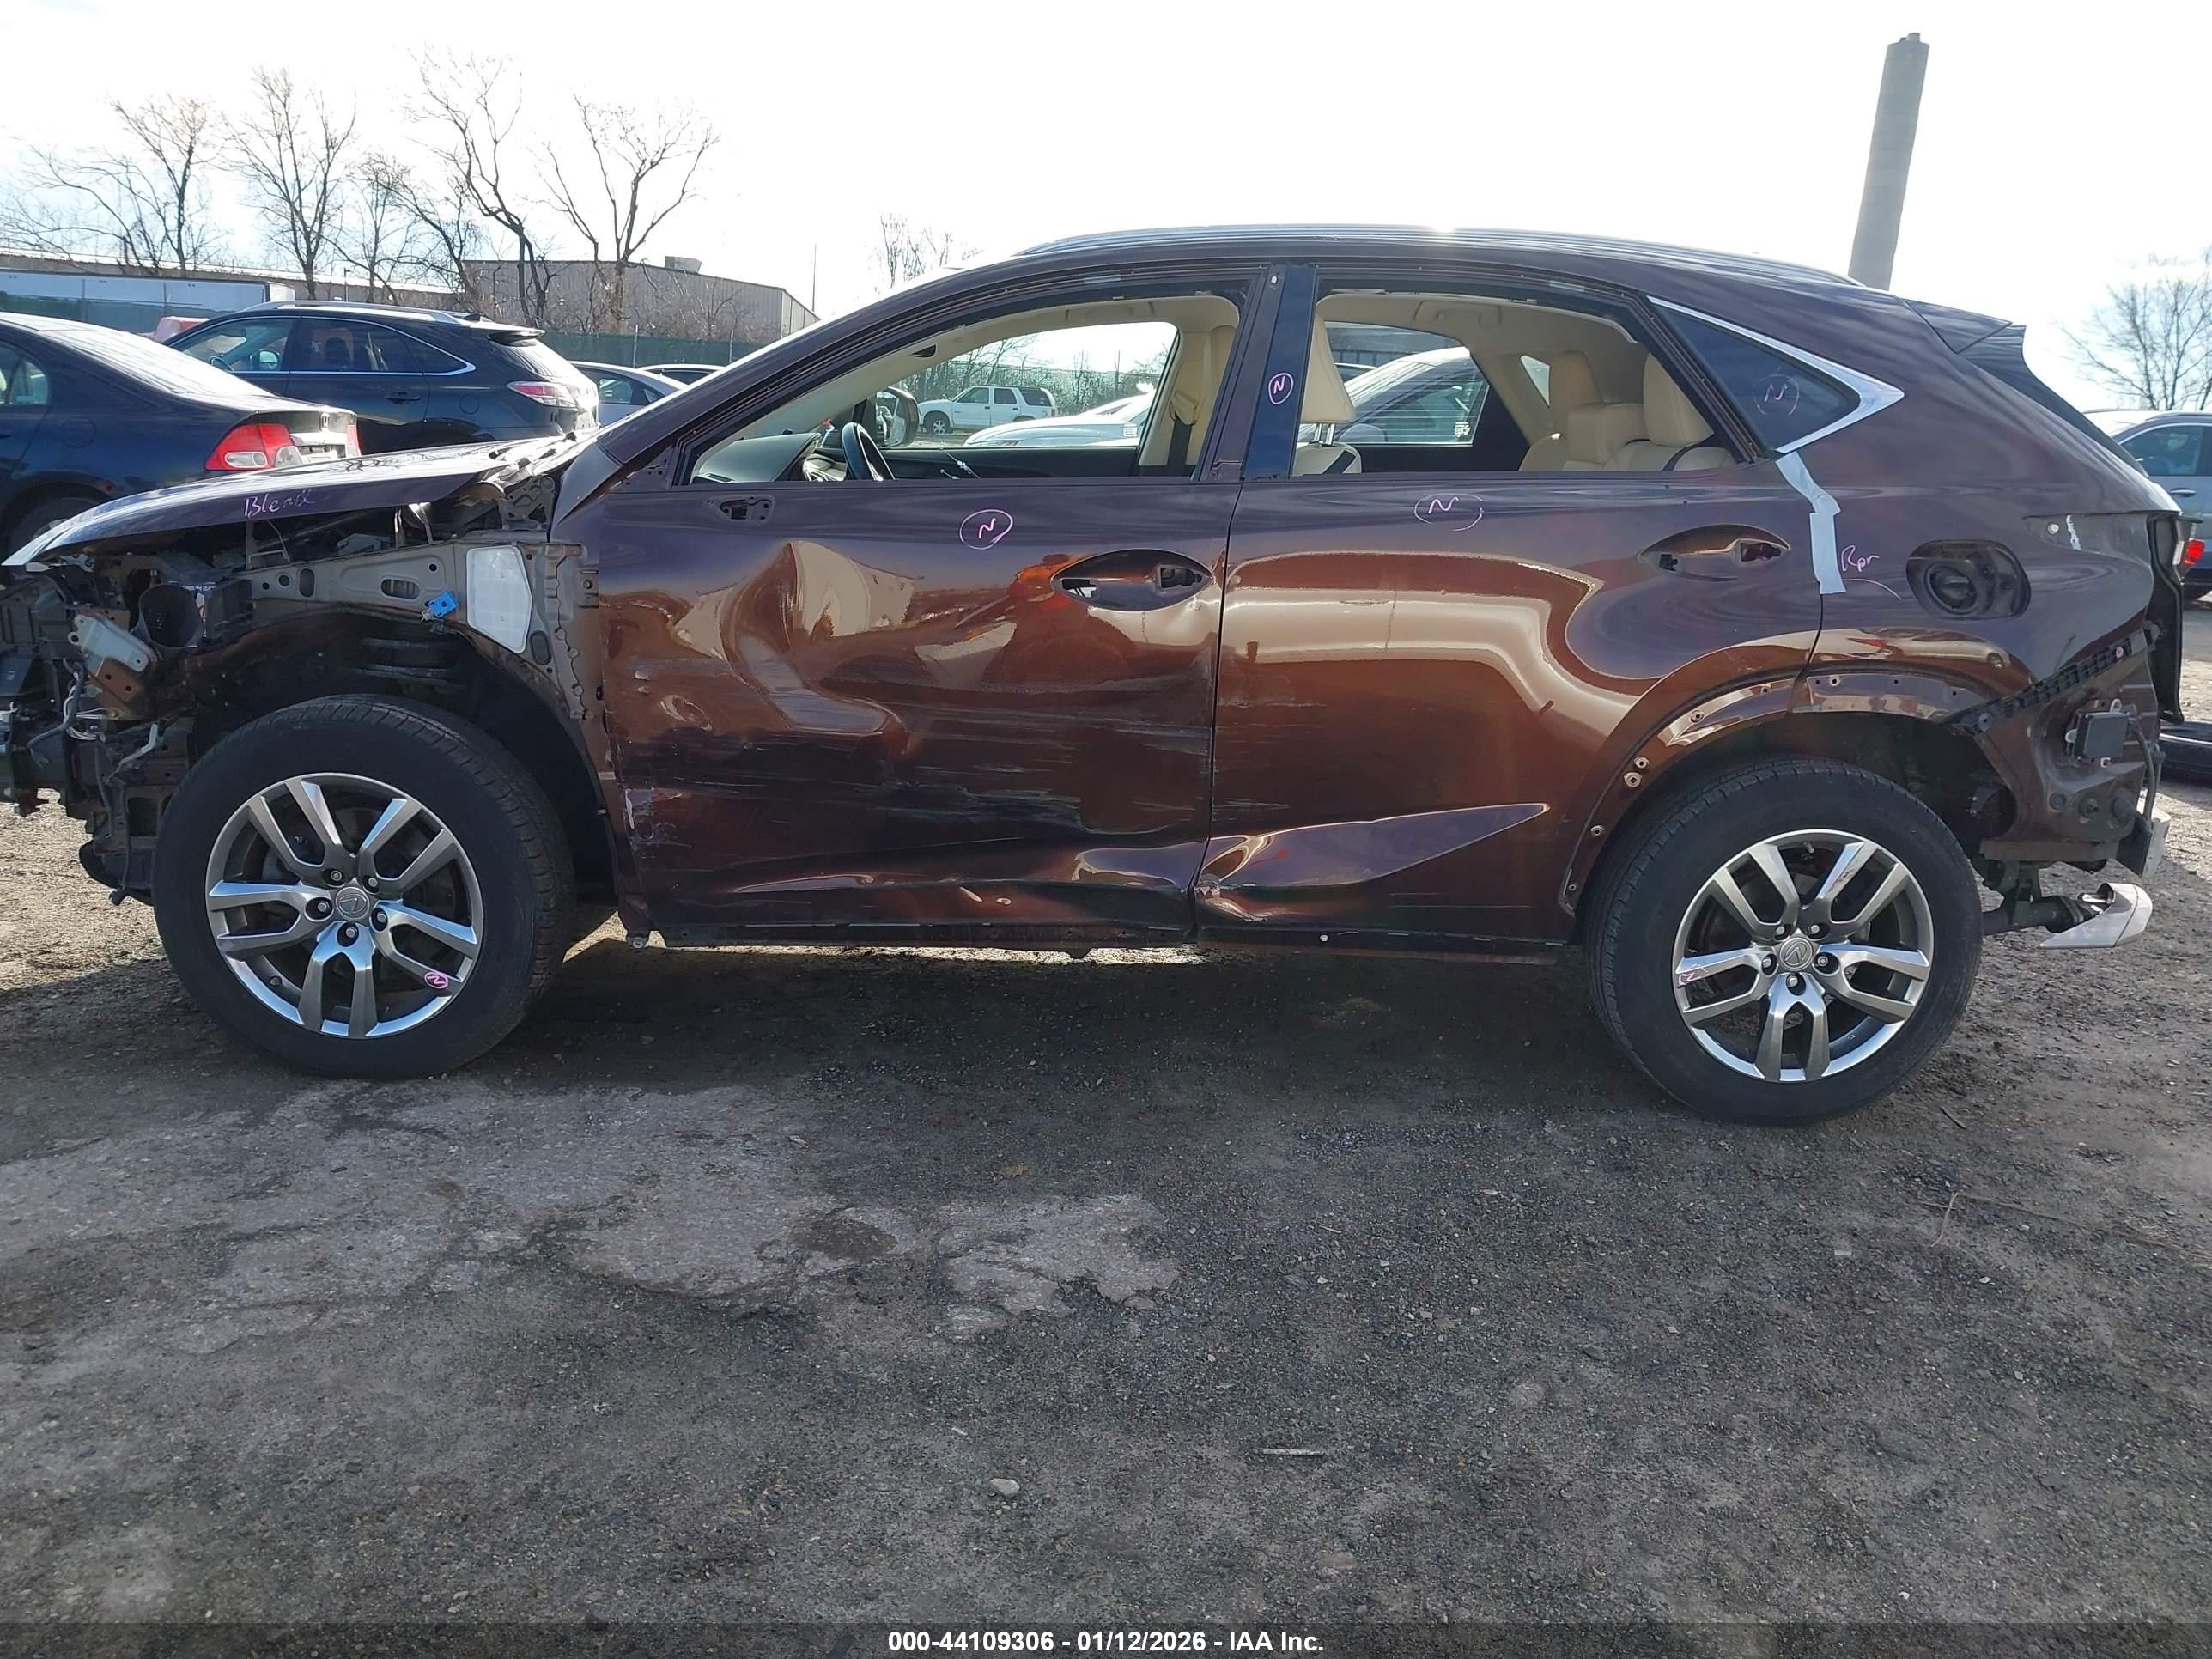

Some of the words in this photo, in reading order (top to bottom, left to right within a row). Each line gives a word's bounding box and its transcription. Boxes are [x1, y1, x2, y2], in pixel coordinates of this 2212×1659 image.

[1273, 375, 1285, 394] N
[1428, 496, 1459, 514] N
[978, 517, 997, 539] N
